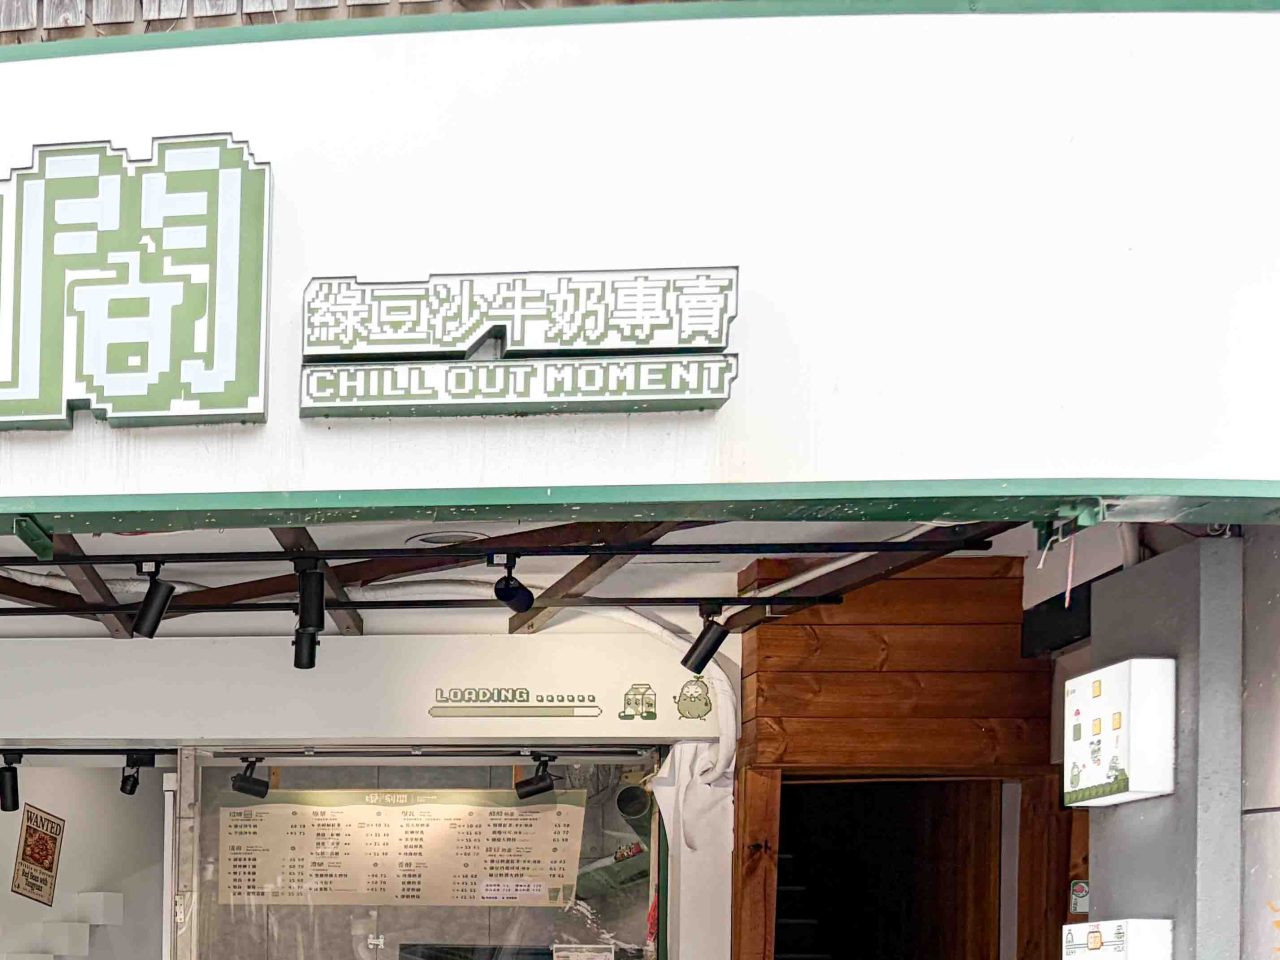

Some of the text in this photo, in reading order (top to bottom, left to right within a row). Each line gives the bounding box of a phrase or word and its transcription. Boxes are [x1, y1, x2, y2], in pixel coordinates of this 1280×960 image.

[307, 274, 734, 346] 綠豆沙牛奶專賣
[307, 361, 728, 401] CHILL OUT MOMENT
[435, 688, 530, 703] LOADING
[25, 809, 62, 836] WANTED
